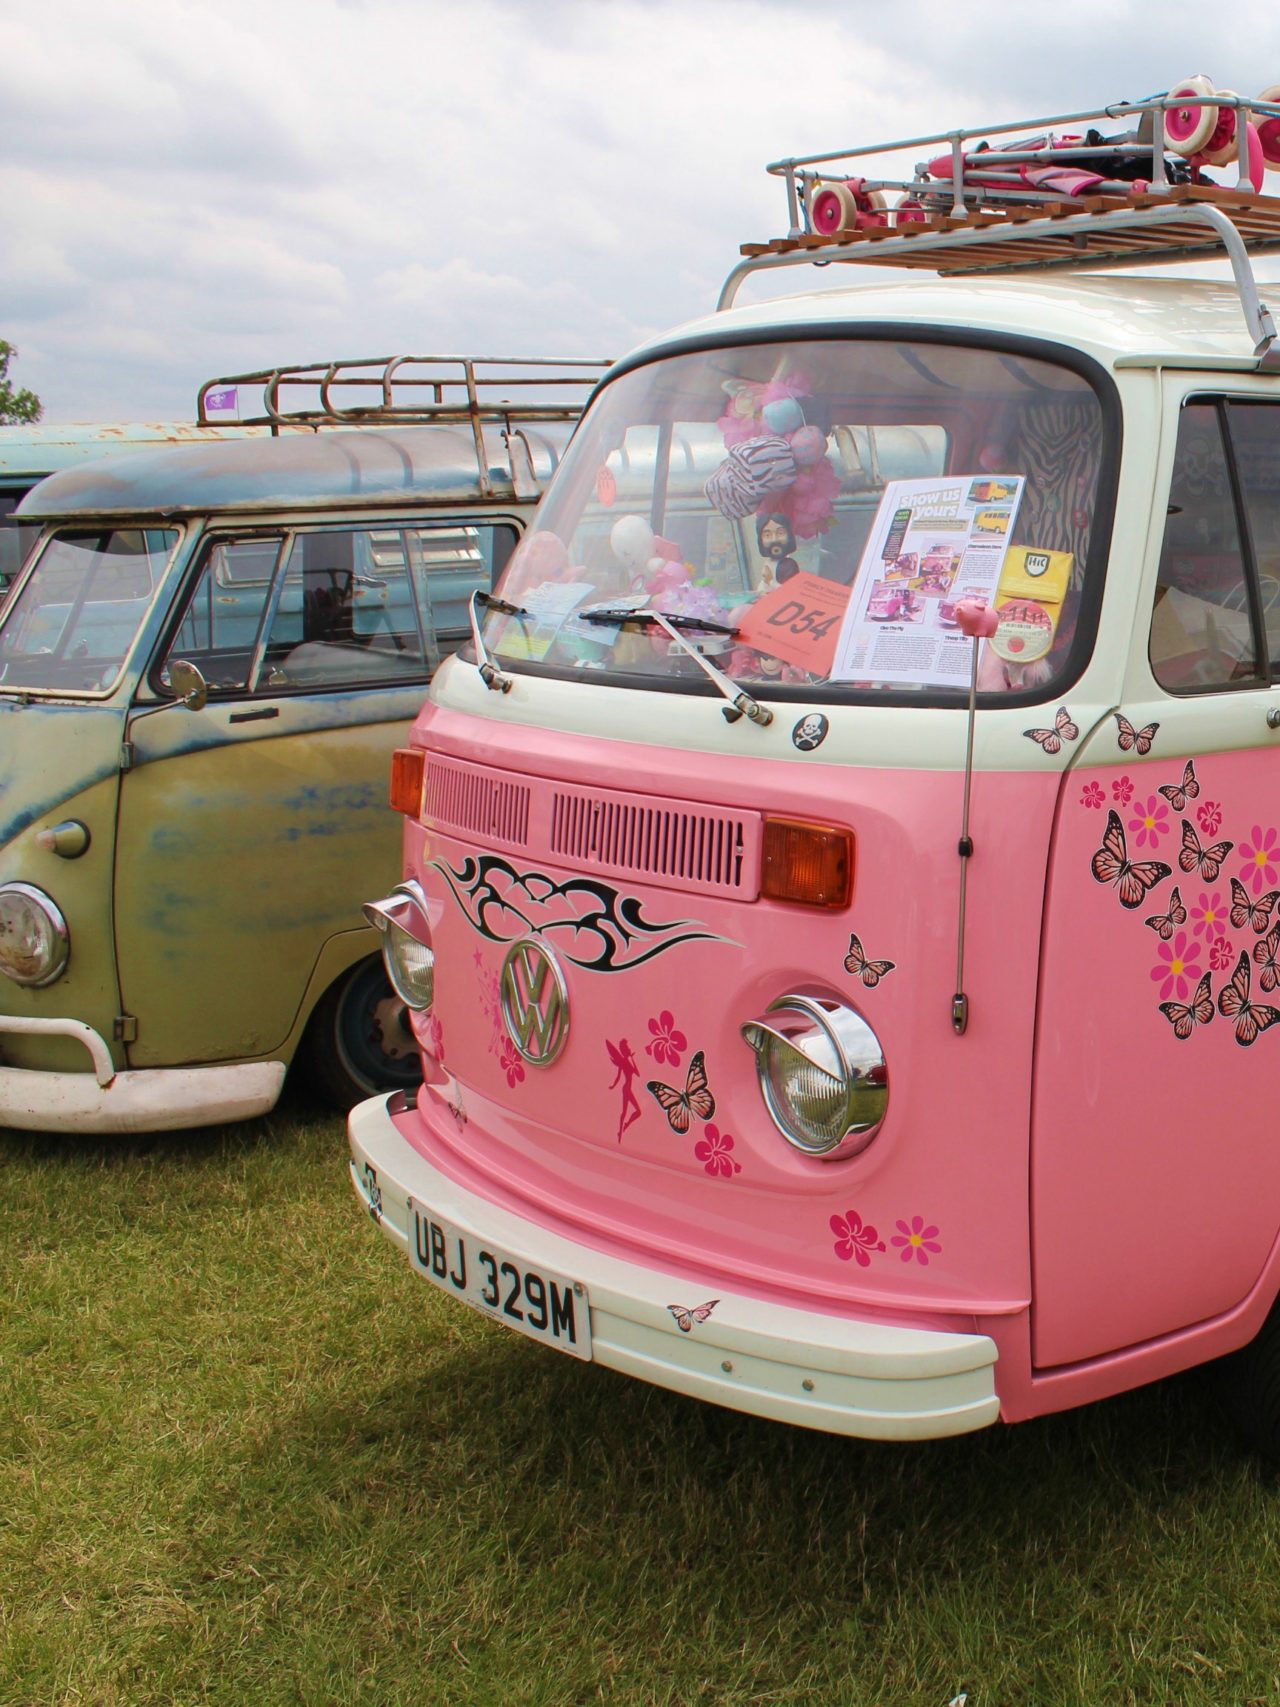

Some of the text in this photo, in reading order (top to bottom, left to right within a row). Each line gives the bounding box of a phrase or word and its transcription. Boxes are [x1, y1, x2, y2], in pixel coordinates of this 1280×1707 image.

[914, 504, 956, 519] yours
[766, 601, 841, 641] D54
[415, 1210, 577, 1344] UBJ 329M
